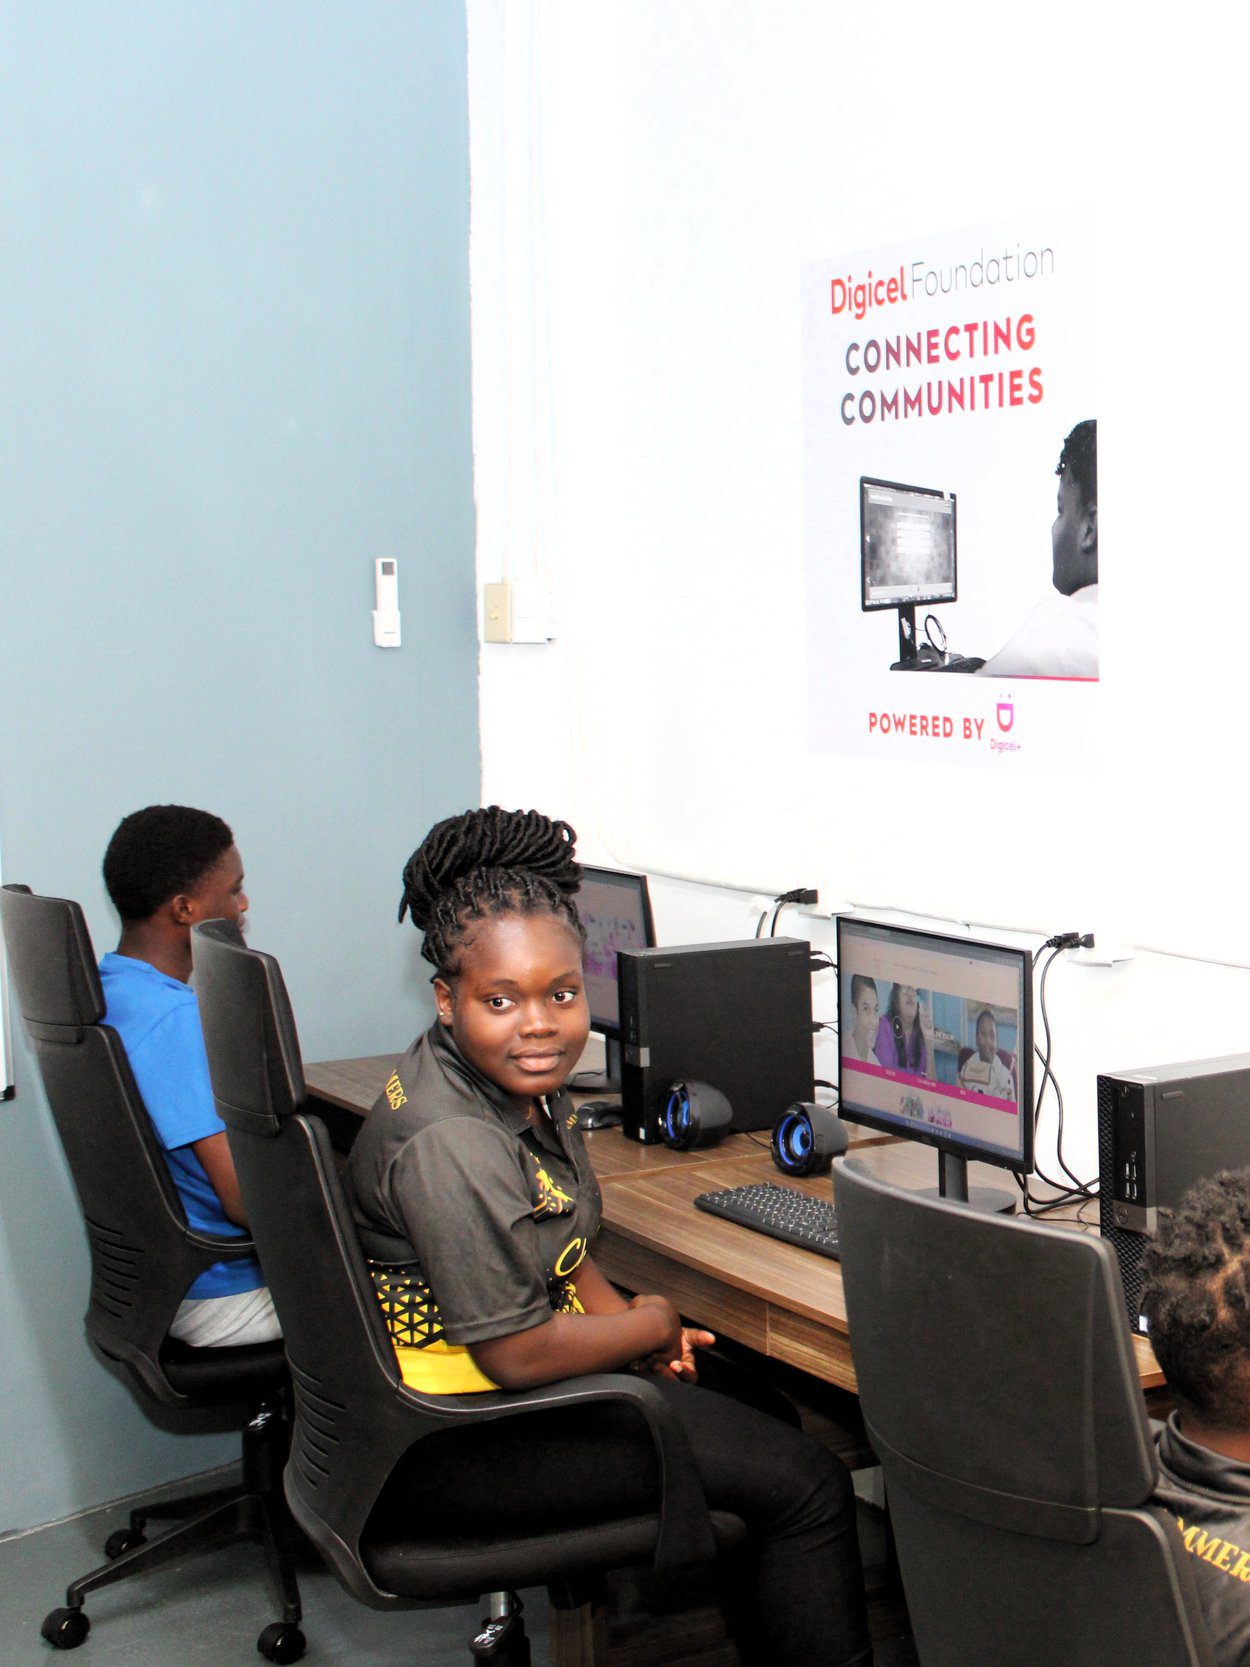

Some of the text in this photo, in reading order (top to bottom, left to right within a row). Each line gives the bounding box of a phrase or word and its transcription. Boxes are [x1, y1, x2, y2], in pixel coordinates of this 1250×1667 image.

[830, 243, 1054, 320] Digicel Foundation
[845, 313, 1036, 376] CONNECTING
[840, 366, 1044, 426] COMMUNITIES
[868, 712, 985, 740] POWERED BY
